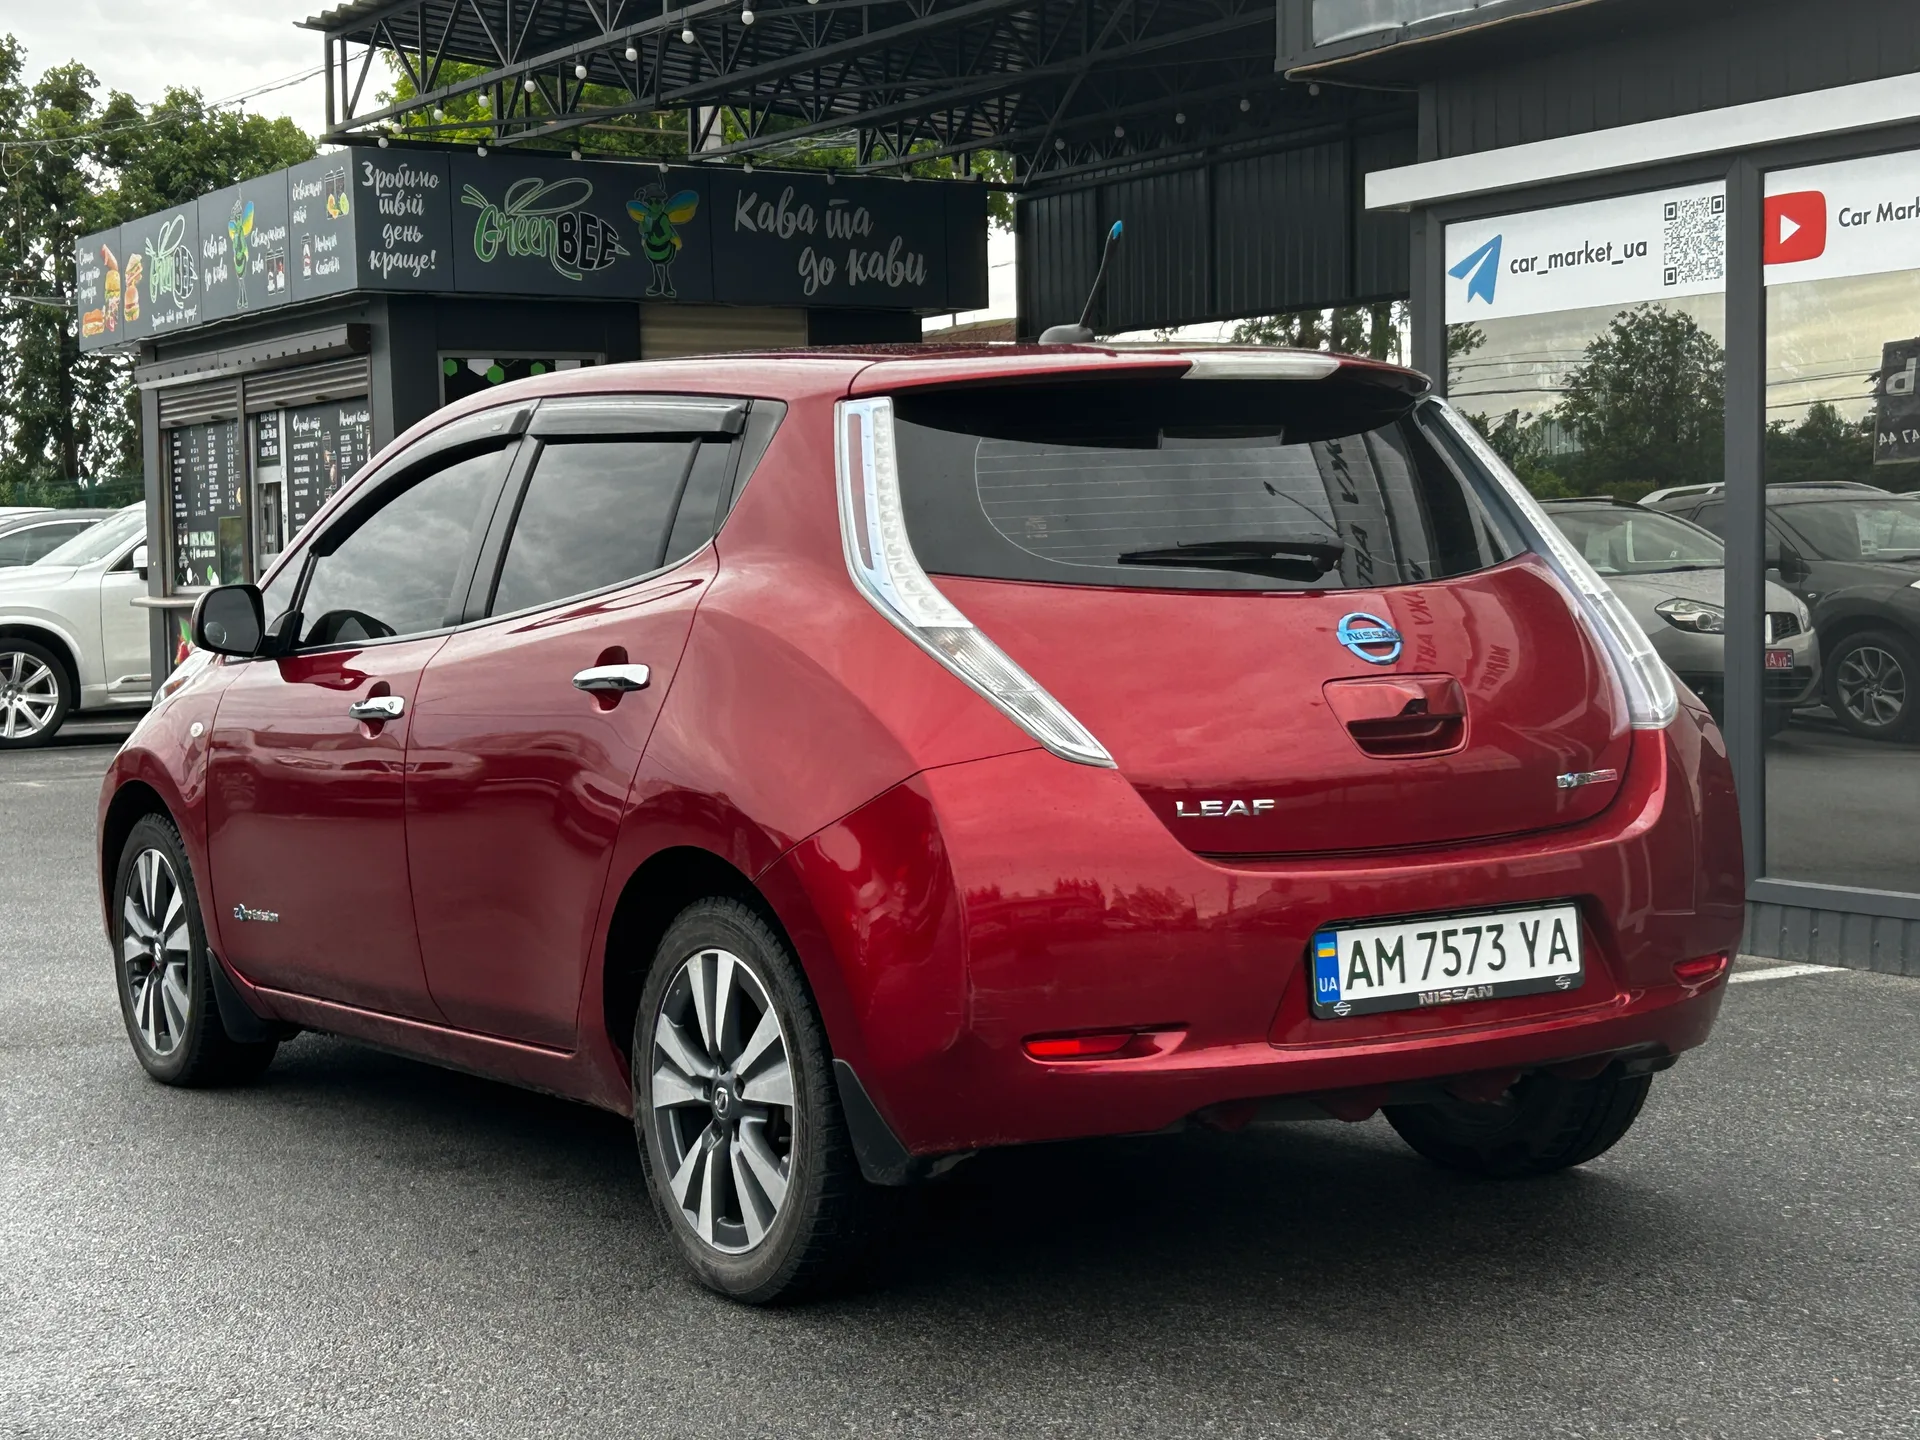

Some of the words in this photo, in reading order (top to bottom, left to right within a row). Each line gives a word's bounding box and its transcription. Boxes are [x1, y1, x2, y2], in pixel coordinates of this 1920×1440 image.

[378, 189, 425, 216] твій
[734, 185, 817, 241] Кава
[826, 199, 874, 240] та
[1838, 207, 1872, 227] Car
[382, 223, 424, 249] день
[368, 250, 437, 279] краще!
[798, 246, 838, 296] до
[848, 235, 928, 288] кави
[1510, 240, 1647, 276] car_market_ua
[1346, 630, 1400, 642] NISSAN
[1175, 799, 1275, 818] LEAF
[1345, 935, 1405, 990] AM
[1416, 924, 1507, 981] 7573
[1520, 918, 1572, 968] YA
[1319, 976, 1338, 992] UA
[1418, 985, 1494, 1006] NISSAN
